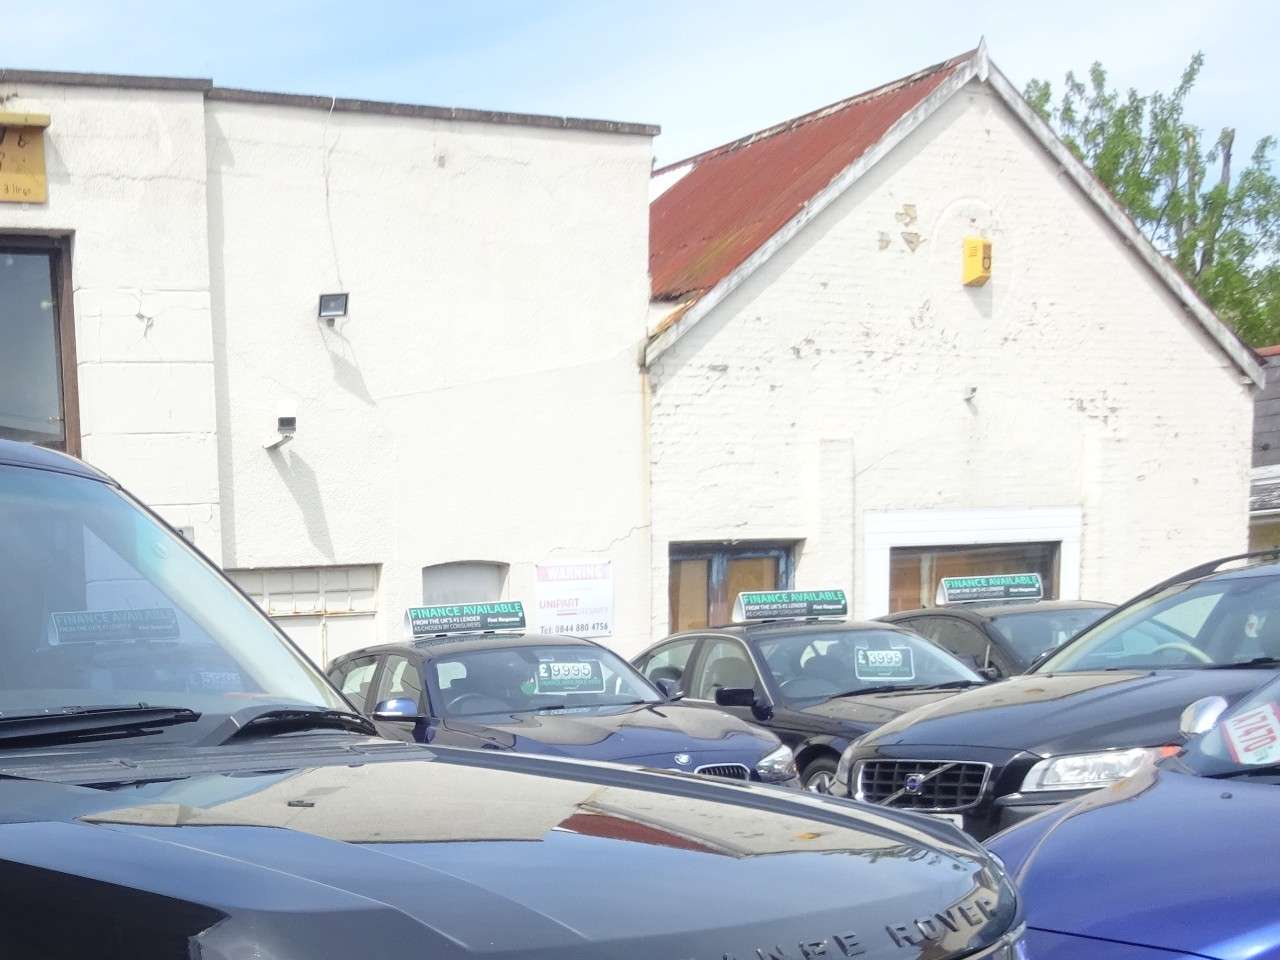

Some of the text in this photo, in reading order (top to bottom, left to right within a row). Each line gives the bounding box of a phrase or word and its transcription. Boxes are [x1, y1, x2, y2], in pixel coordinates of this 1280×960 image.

[945, 580, 988, 588] FINANCE
[743, 591, 844, 604] FINANCE AVAILABLE
[411, 602, 523, 620] FINANCE AVAILABLE
[885, 898, 998, 949] ROVER
